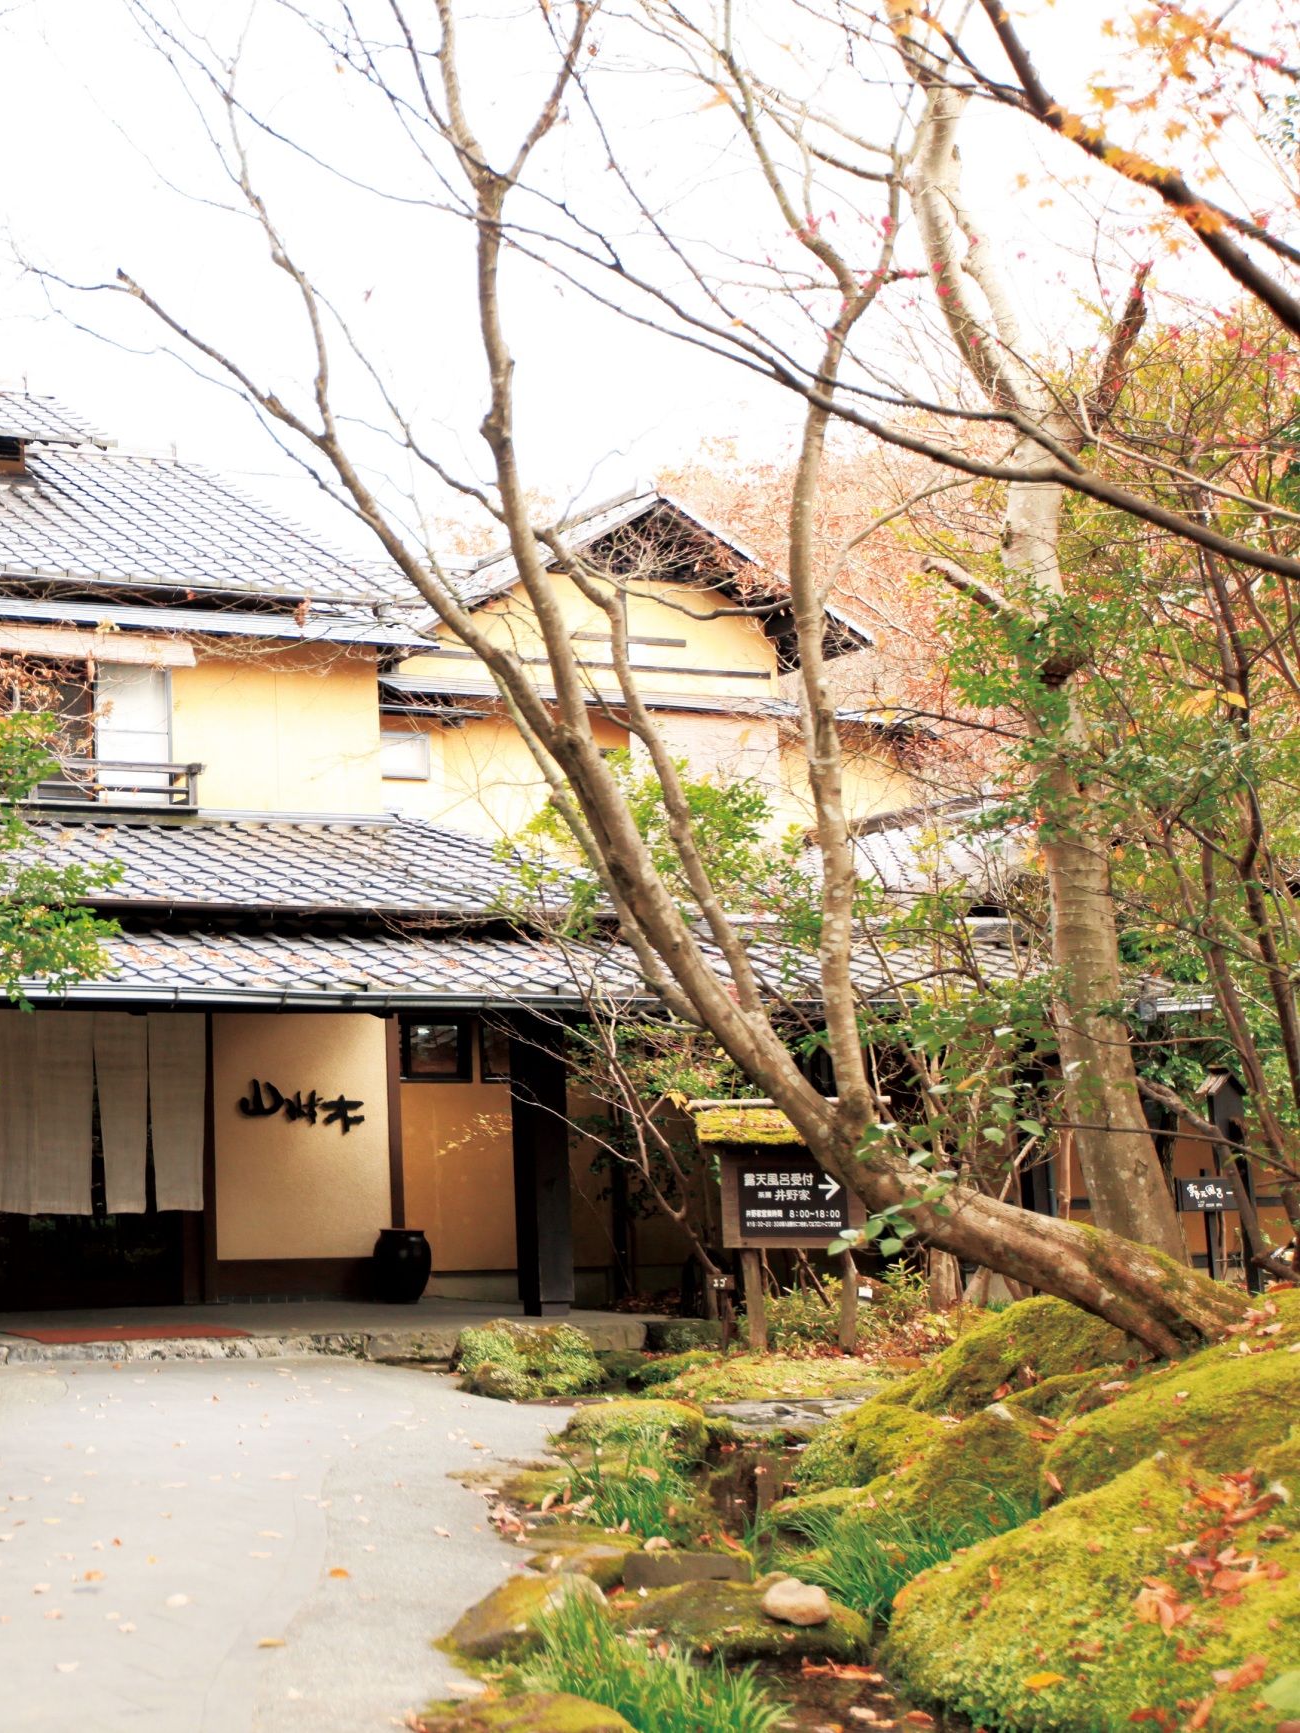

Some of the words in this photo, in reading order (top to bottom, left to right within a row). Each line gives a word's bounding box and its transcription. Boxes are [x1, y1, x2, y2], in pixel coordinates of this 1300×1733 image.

[743, 1173, 814, 1187] 露天風呂受付
[774, 1189, 811, 1201] 井野家
